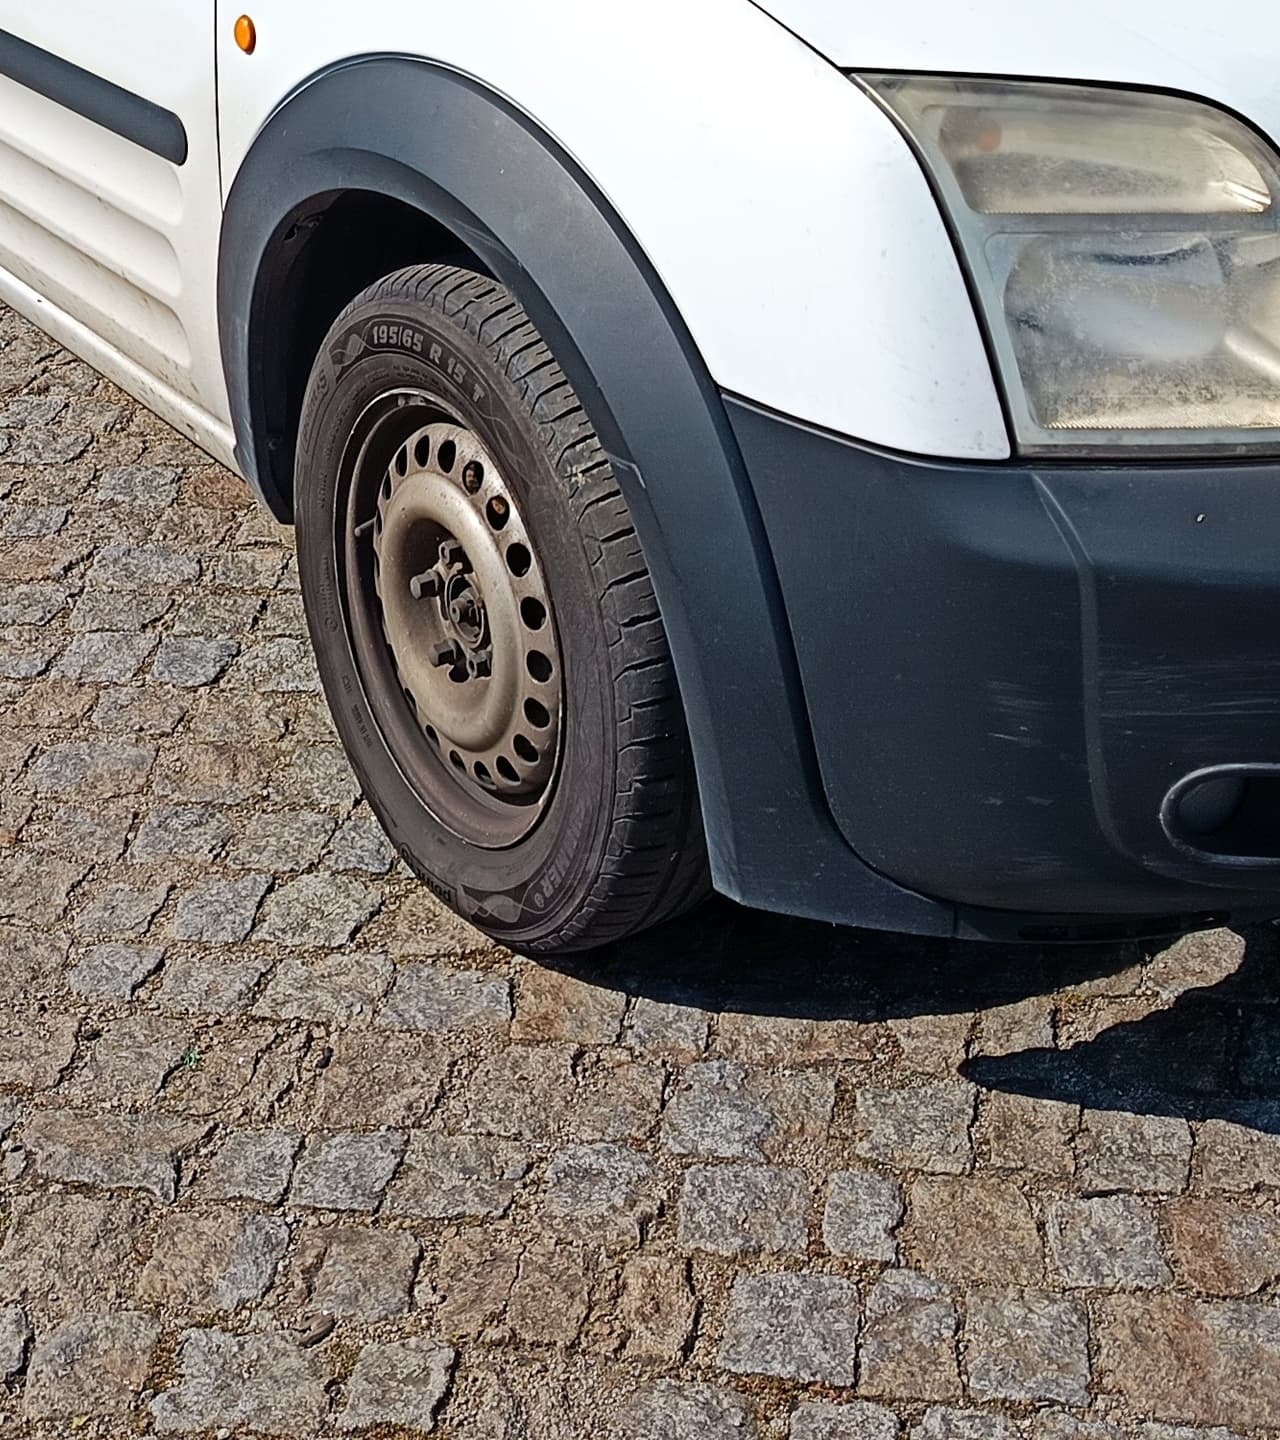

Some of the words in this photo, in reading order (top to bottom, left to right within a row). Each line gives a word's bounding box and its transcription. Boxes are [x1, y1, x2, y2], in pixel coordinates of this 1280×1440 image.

[372, 325, 424, 352] 195/65
[429, 343, 442, 364] R
[447, 358, 468, 385] 15
